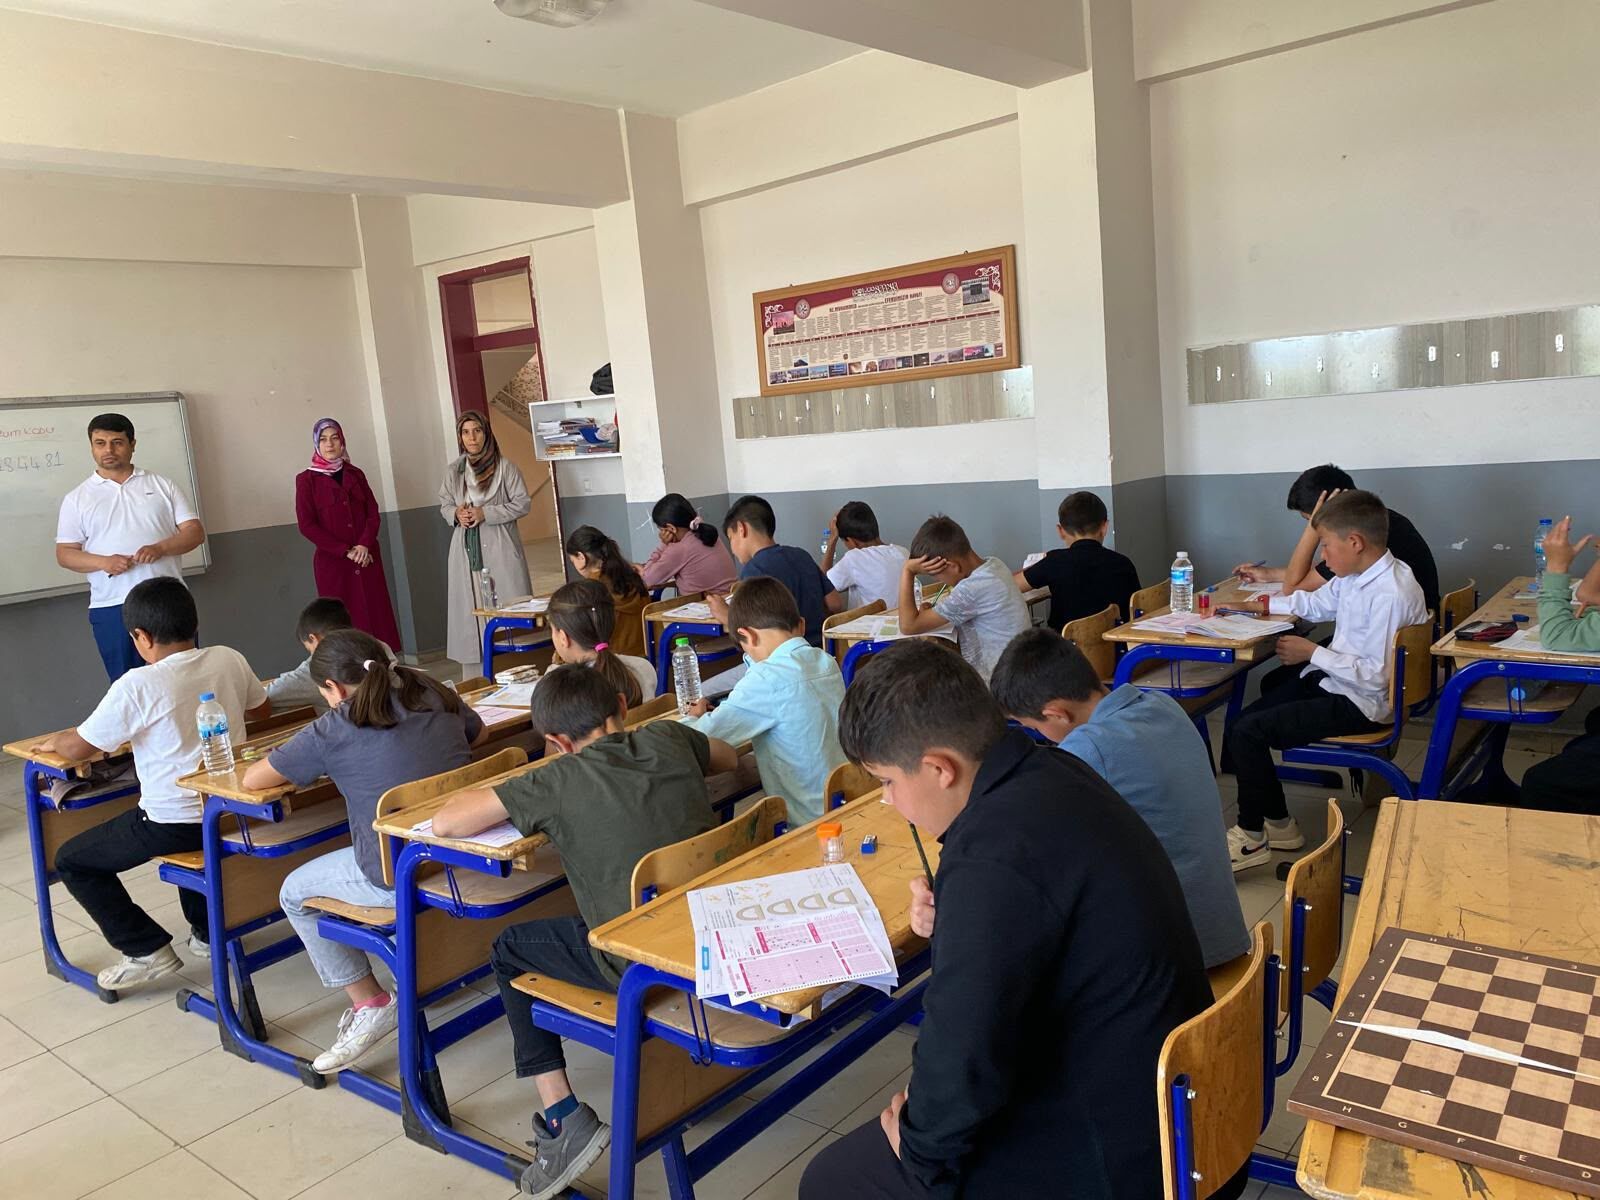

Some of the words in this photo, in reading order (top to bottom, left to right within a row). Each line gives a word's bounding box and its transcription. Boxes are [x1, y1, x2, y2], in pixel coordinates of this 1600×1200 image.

[1341, 1105, 1353, 1114] H
[1397, 1121, 1408, 1129] G
[1456, 1137, 1467, 1145] F
[1518, 1153, 1529, 1163] E
[1581, 1170, 1592, 1179] D
